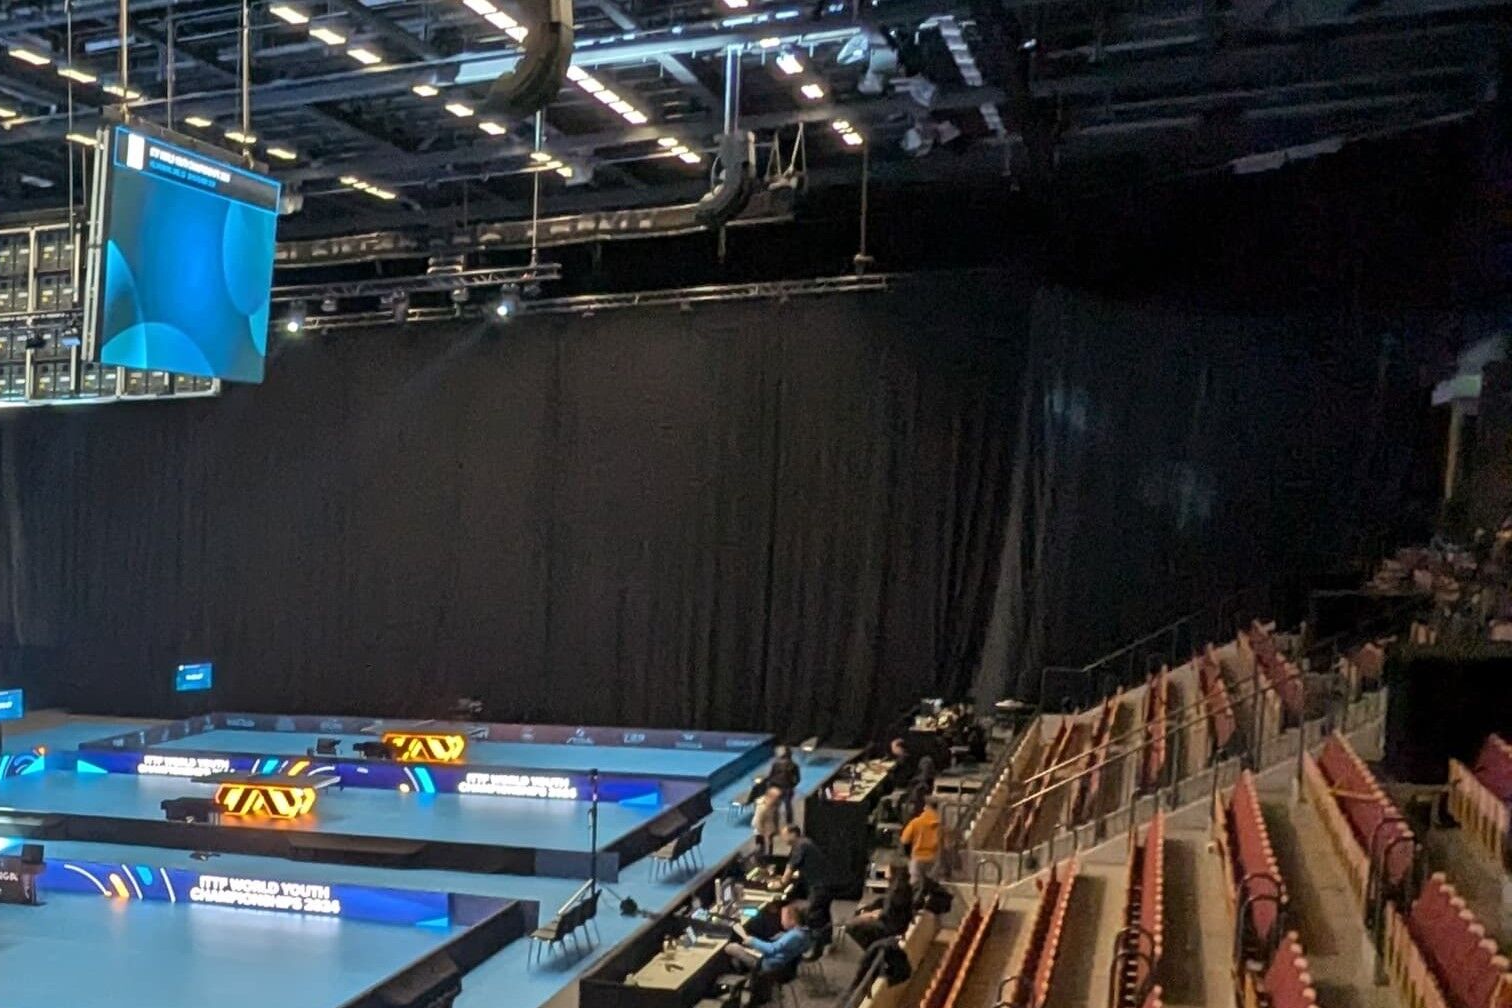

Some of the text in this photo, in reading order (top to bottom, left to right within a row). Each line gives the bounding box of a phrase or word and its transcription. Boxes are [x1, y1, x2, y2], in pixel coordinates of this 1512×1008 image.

[190, 886, 341, 914] CHAMPIONSHIPS 2024
[199, 875, 331, 900] ITTF WORLD YOUTH
